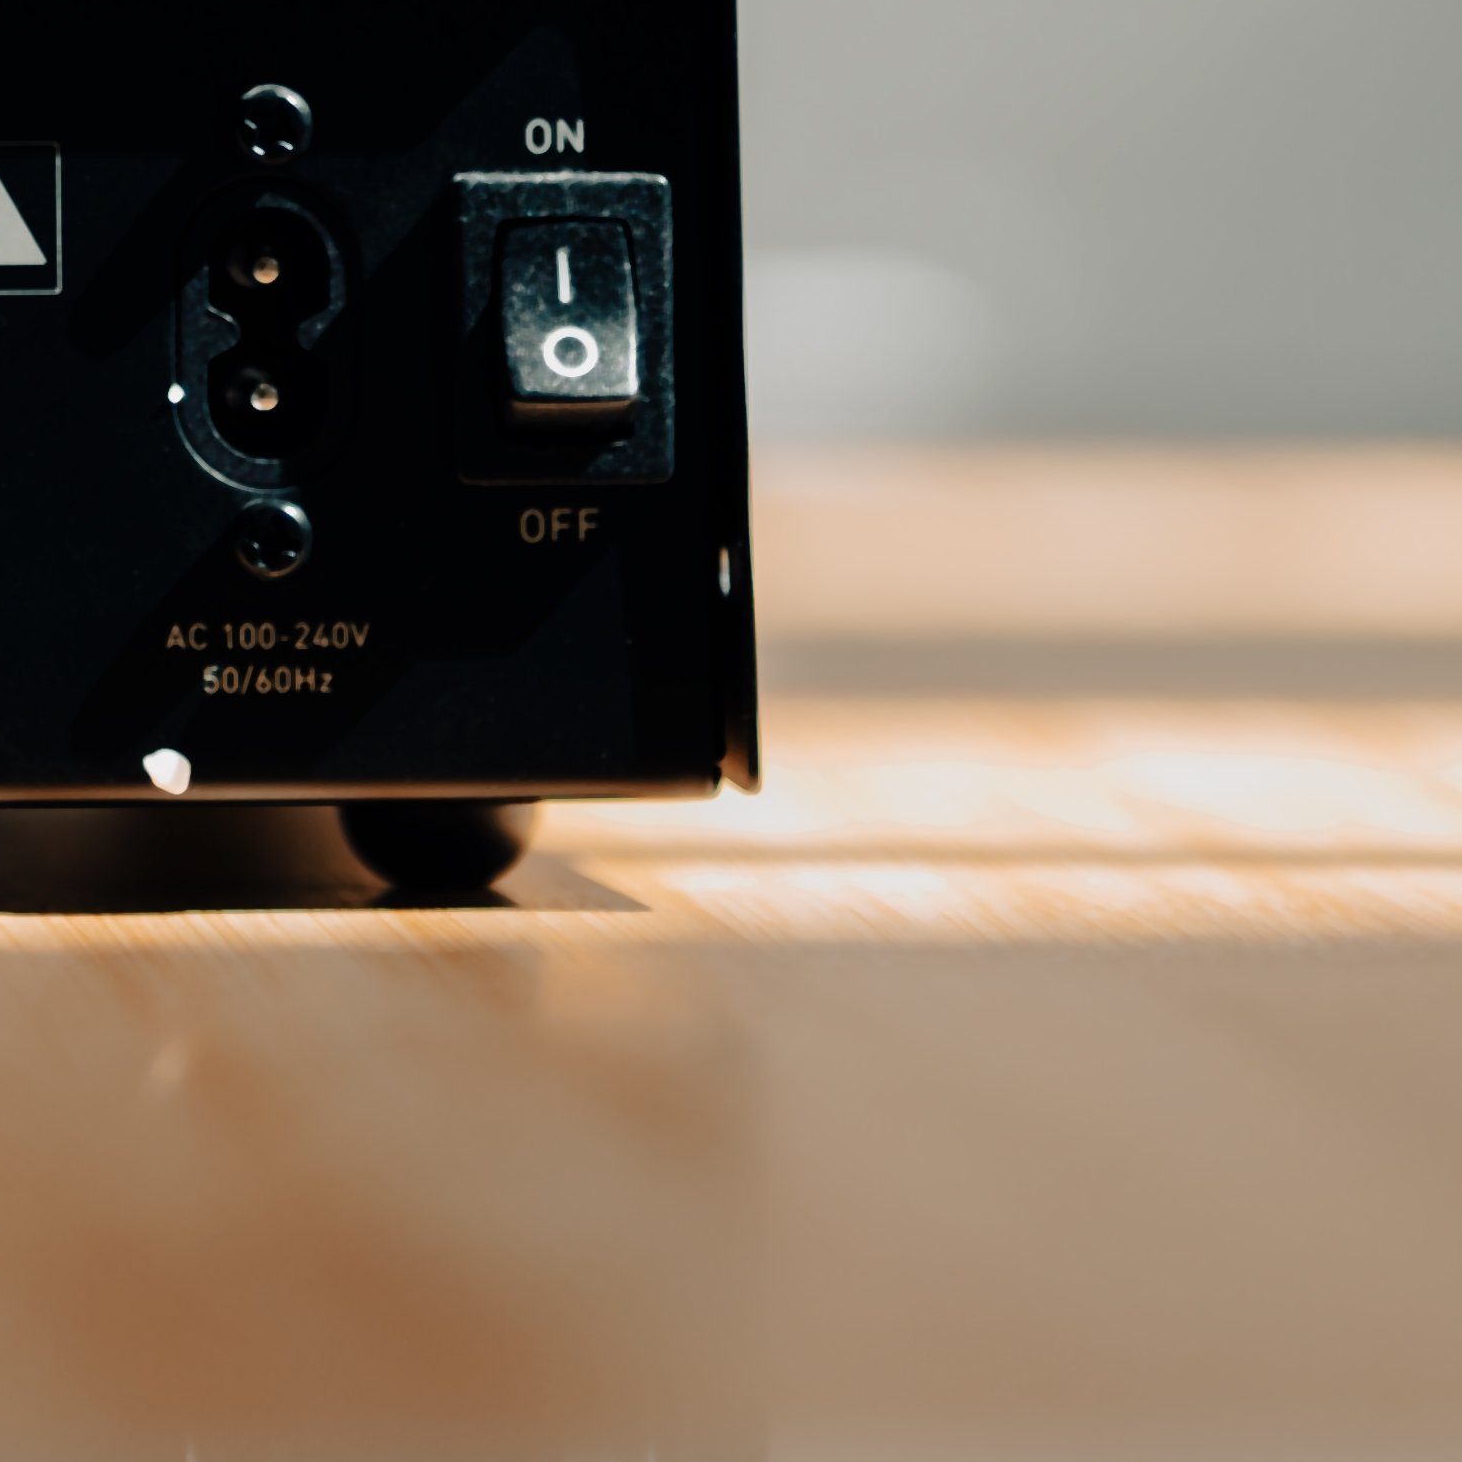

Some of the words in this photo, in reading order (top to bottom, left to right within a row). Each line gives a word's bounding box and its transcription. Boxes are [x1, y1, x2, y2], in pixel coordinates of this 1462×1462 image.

[524, 118, 585, 156] ON
[518, 506, 601, 544] OFF
[165, 622, 209, 651] AC
[223, 620, 370, 651] 100-240V
[202, 663, 333, 696] 50/60Hz
